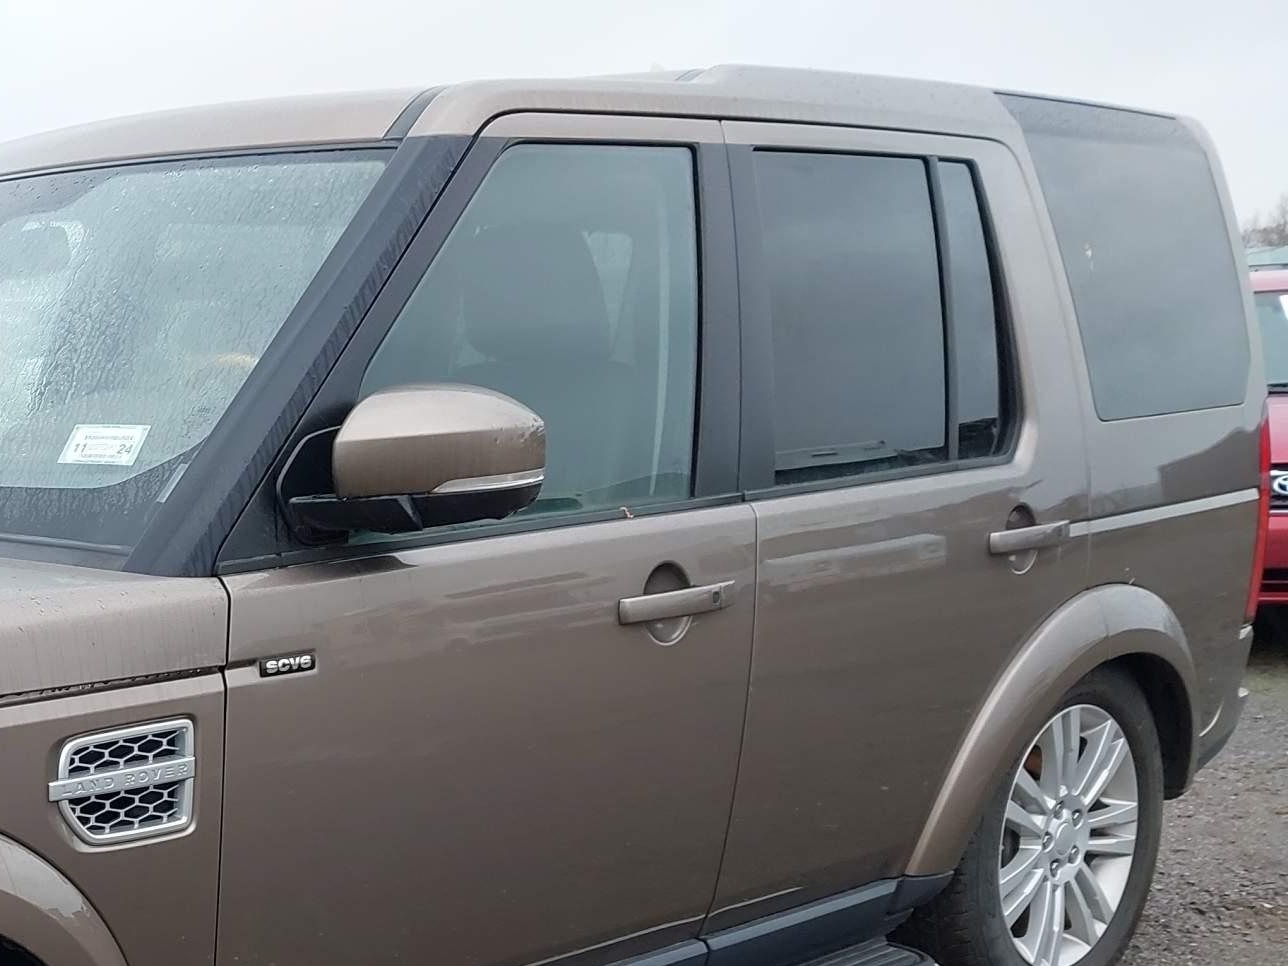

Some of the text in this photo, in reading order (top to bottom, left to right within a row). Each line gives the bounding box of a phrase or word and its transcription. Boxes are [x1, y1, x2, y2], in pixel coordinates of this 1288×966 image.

[116, 443, 133, 455] 24
[266, 655, 312, 673] SCV6
[62, 763, 188, 797] LAND ROVER
